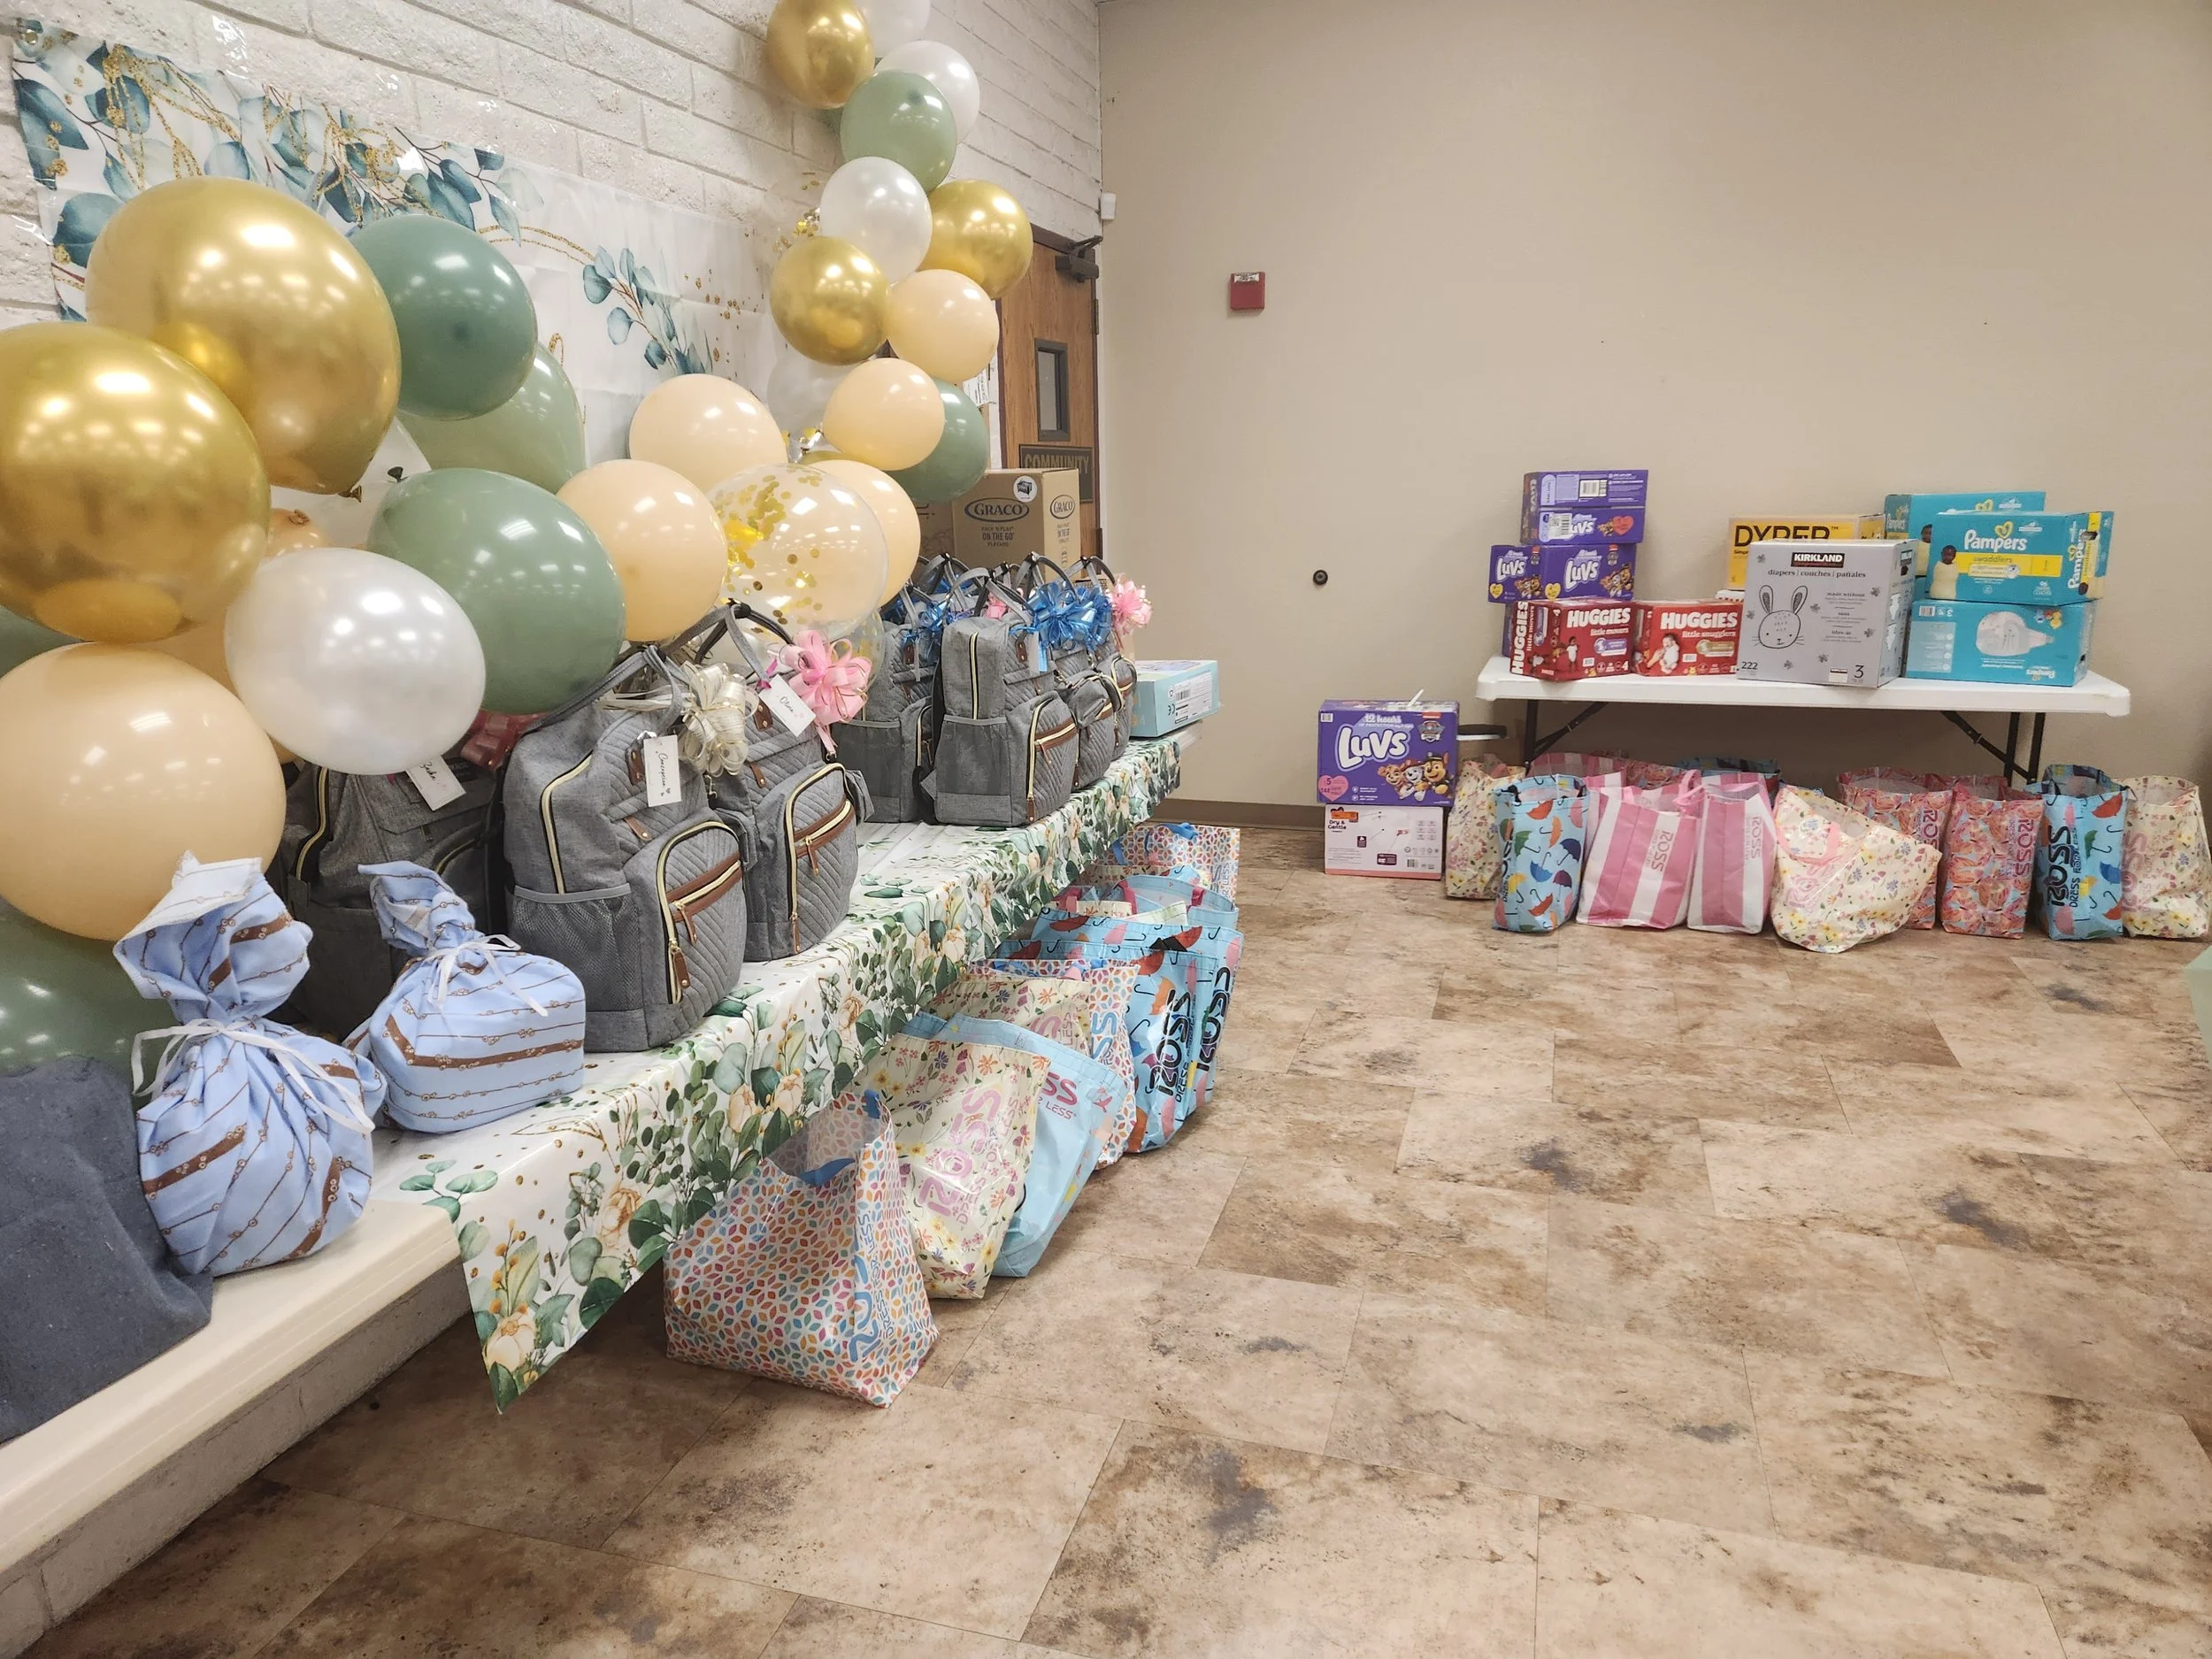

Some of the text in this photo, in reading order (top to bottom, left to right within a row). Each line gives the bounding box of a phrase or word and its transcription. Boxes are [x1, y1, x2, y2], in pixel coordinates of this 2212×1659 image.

[1025, 453, 1089, 473] COMMUNITY
[974, 503, 1023, 516] GRACO
[1053, 501, 1073, 514] GRACO
[1964, 529, 2028, 553] Pampers
[1768, 569, 1795, 578] diapers
[1793, 553, 1843, 563] KIRKLAND
[1567, 607, 1631, 628] HUGGIES
[1660, 612, 1738, 629] HUGGIES
[1511, 602, 1528, 674] HUGGIES
[1621, 661, 1629, 671] 4
[1741, 661, 1758, 670] 222
[1854, 664, 1864, 679] 3
[1751, 816, 1763, 859] ROSS
[1923, 810, 1939, 849] ROS
[1651, 830, 1674, 872] ROSS
[2014, 818, 2034, 876] ROSS
[2047, 825, 2071, 907] ROSS
[2069, 877, 2081, 908] DRESS
[1196, 966, 1231, 1072] ROSS
[1145, 988, 1193, 1097] ROSS
[1001, 1096, 1019, 1138] LESS
[1045, 1100, 1076, 1121] LESS
[918, 1087, 1002, 1217] ROSS
[857, 1213, 877, 1254] LESS
[875, 1289, 895, 1340] DRESS
